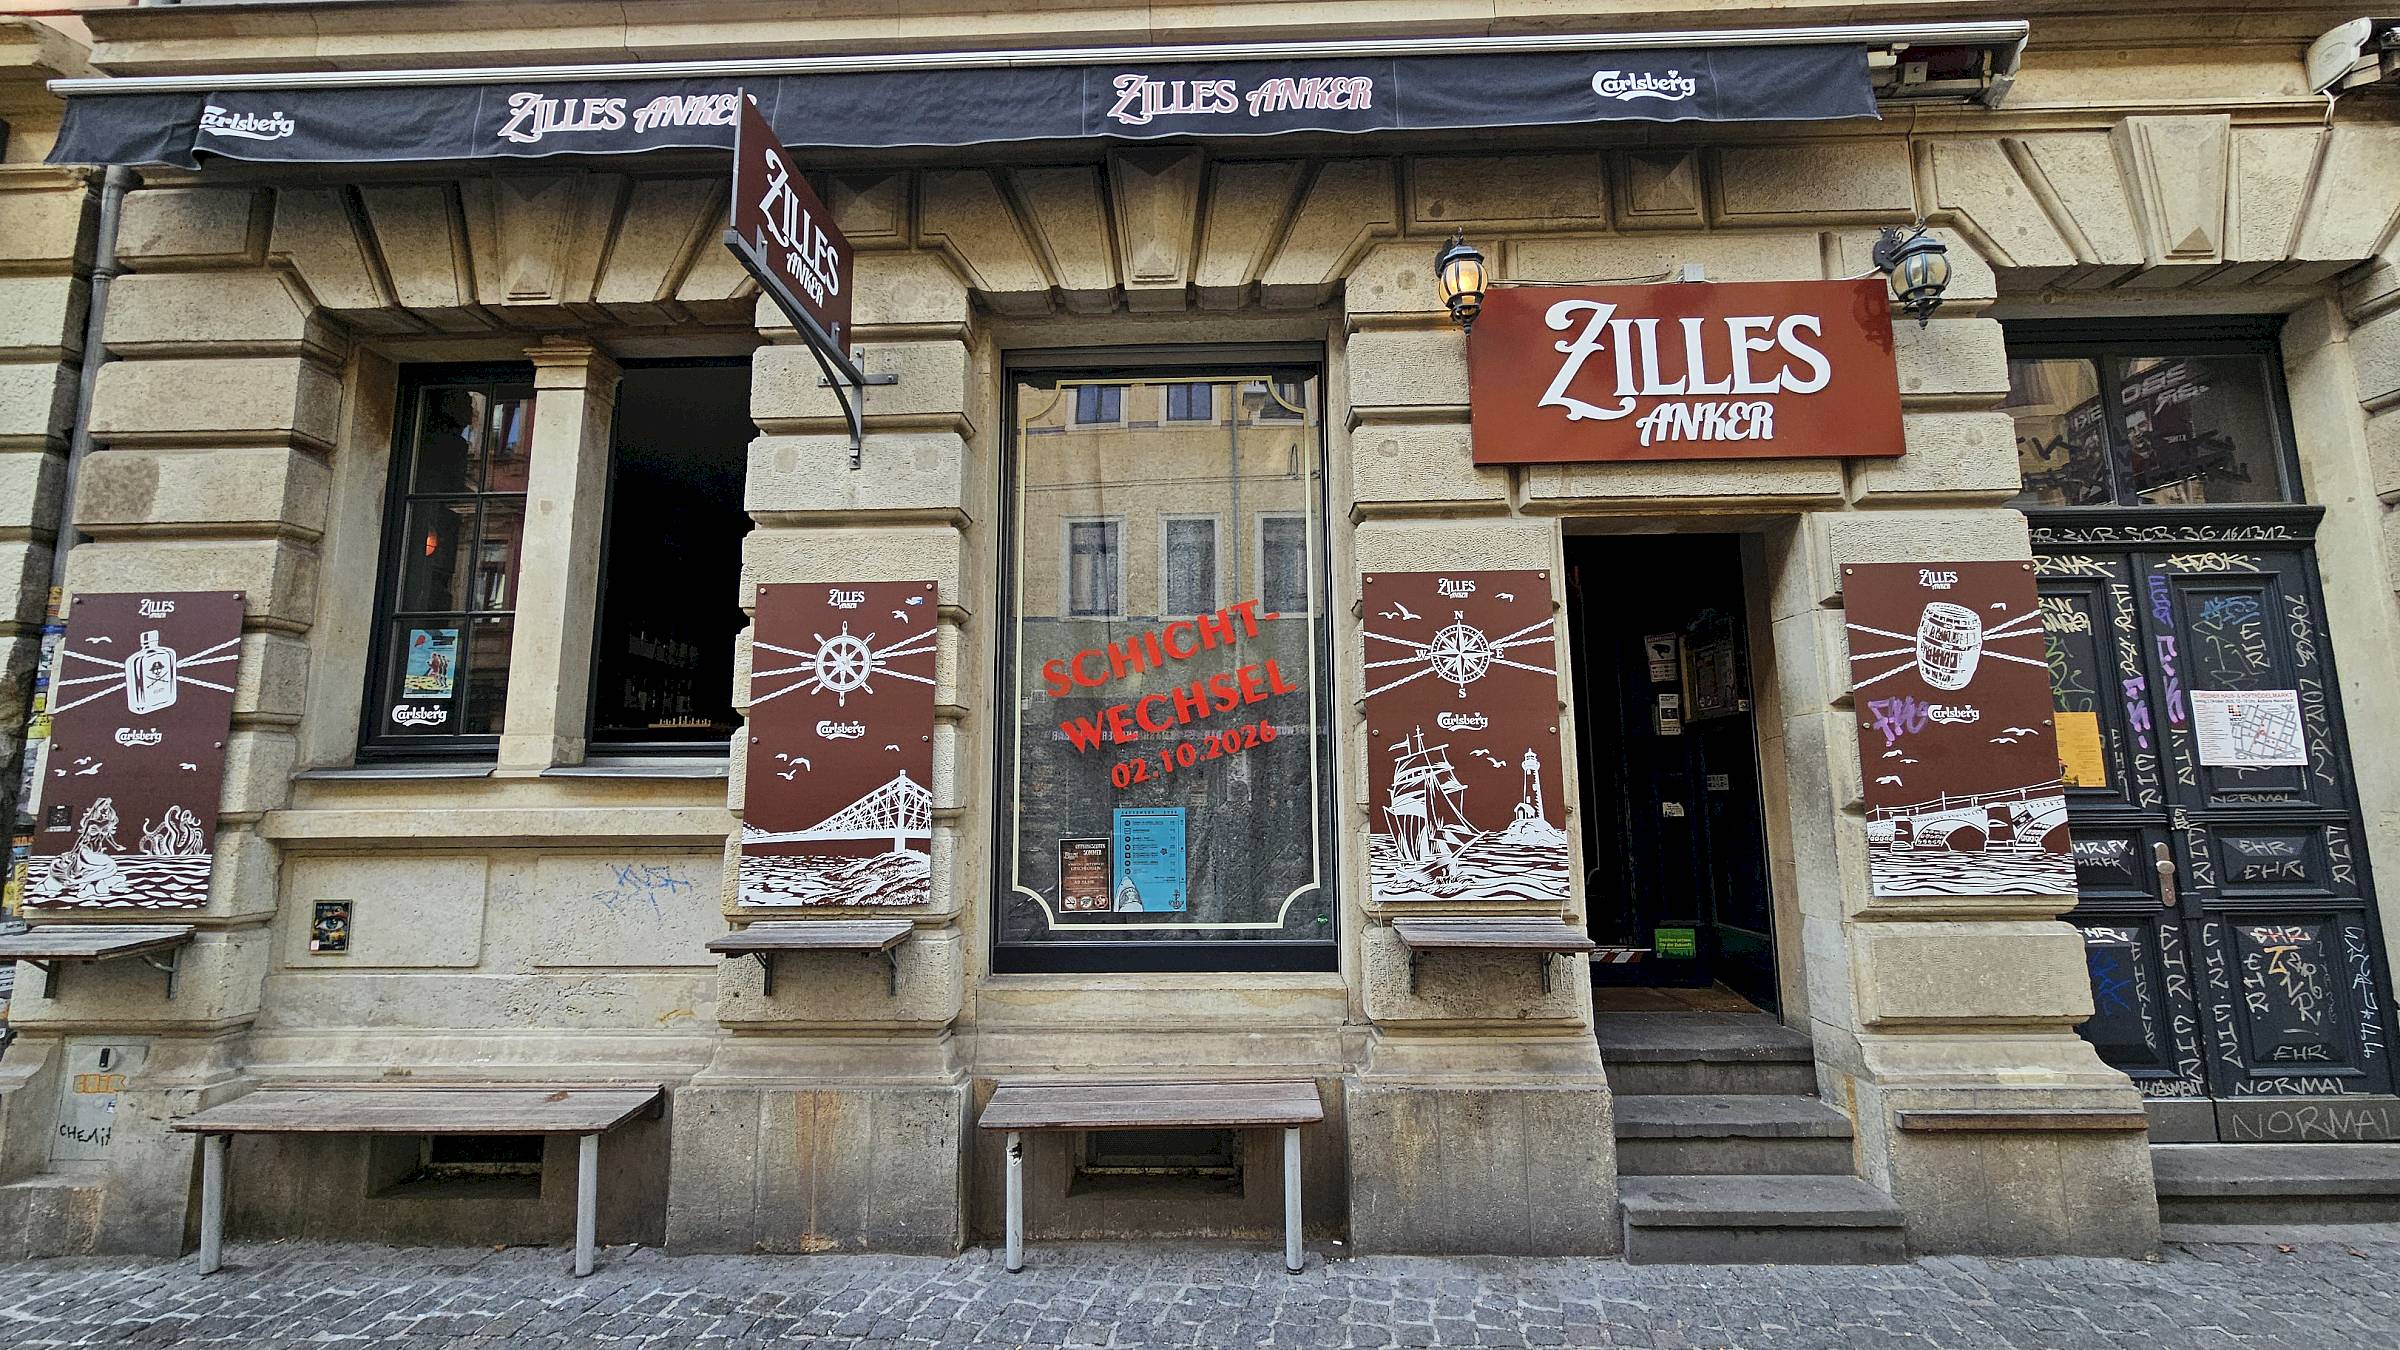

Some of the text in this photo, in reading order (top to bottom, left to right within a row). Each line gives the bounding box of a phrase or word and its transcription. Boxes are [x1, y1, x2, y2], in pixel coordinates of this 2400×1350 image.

[1592, 70, 1695, 101] Carlsberg
[1107, 74, 1372, 124] ZILLES ANKER
[498, 92, 626, 143] ZILLES
[759, 149, 838, 296] ZILLES
[786, 251, 824, 308] ANKER
[1538, 300, 1831, 420] ZILLES
[1636, 401, 1774, 447] ANKER
[1437, 578, 1476, 596] ZILLES
[1919, 569, 1959, 586] ZILLES
[138, 598, 175, 615] ZILLES
[827, 588, 865, 606] ZILLES
[1454, 610, 1464, 620] N
[1042, 599, 1280, 698] SCHICHT-
[1415, 649, 1430, 660] W
[1496, 648, 1505, 659] E
[1458, 688, 1467, 698] S
[1059, 655, 1297, 754] WECHSEL
[1928, 704, 1980, 724] Carlsberg
[392, 704, 448, 727] Carlsberg
[1437, 711, 1489, 732] Carlsberg
[115, 727, 162, 746] Carlsberg
[816, 720, 865, 740] Carlsberg
[1110, 719, 1278, 788] 02.10.2026
